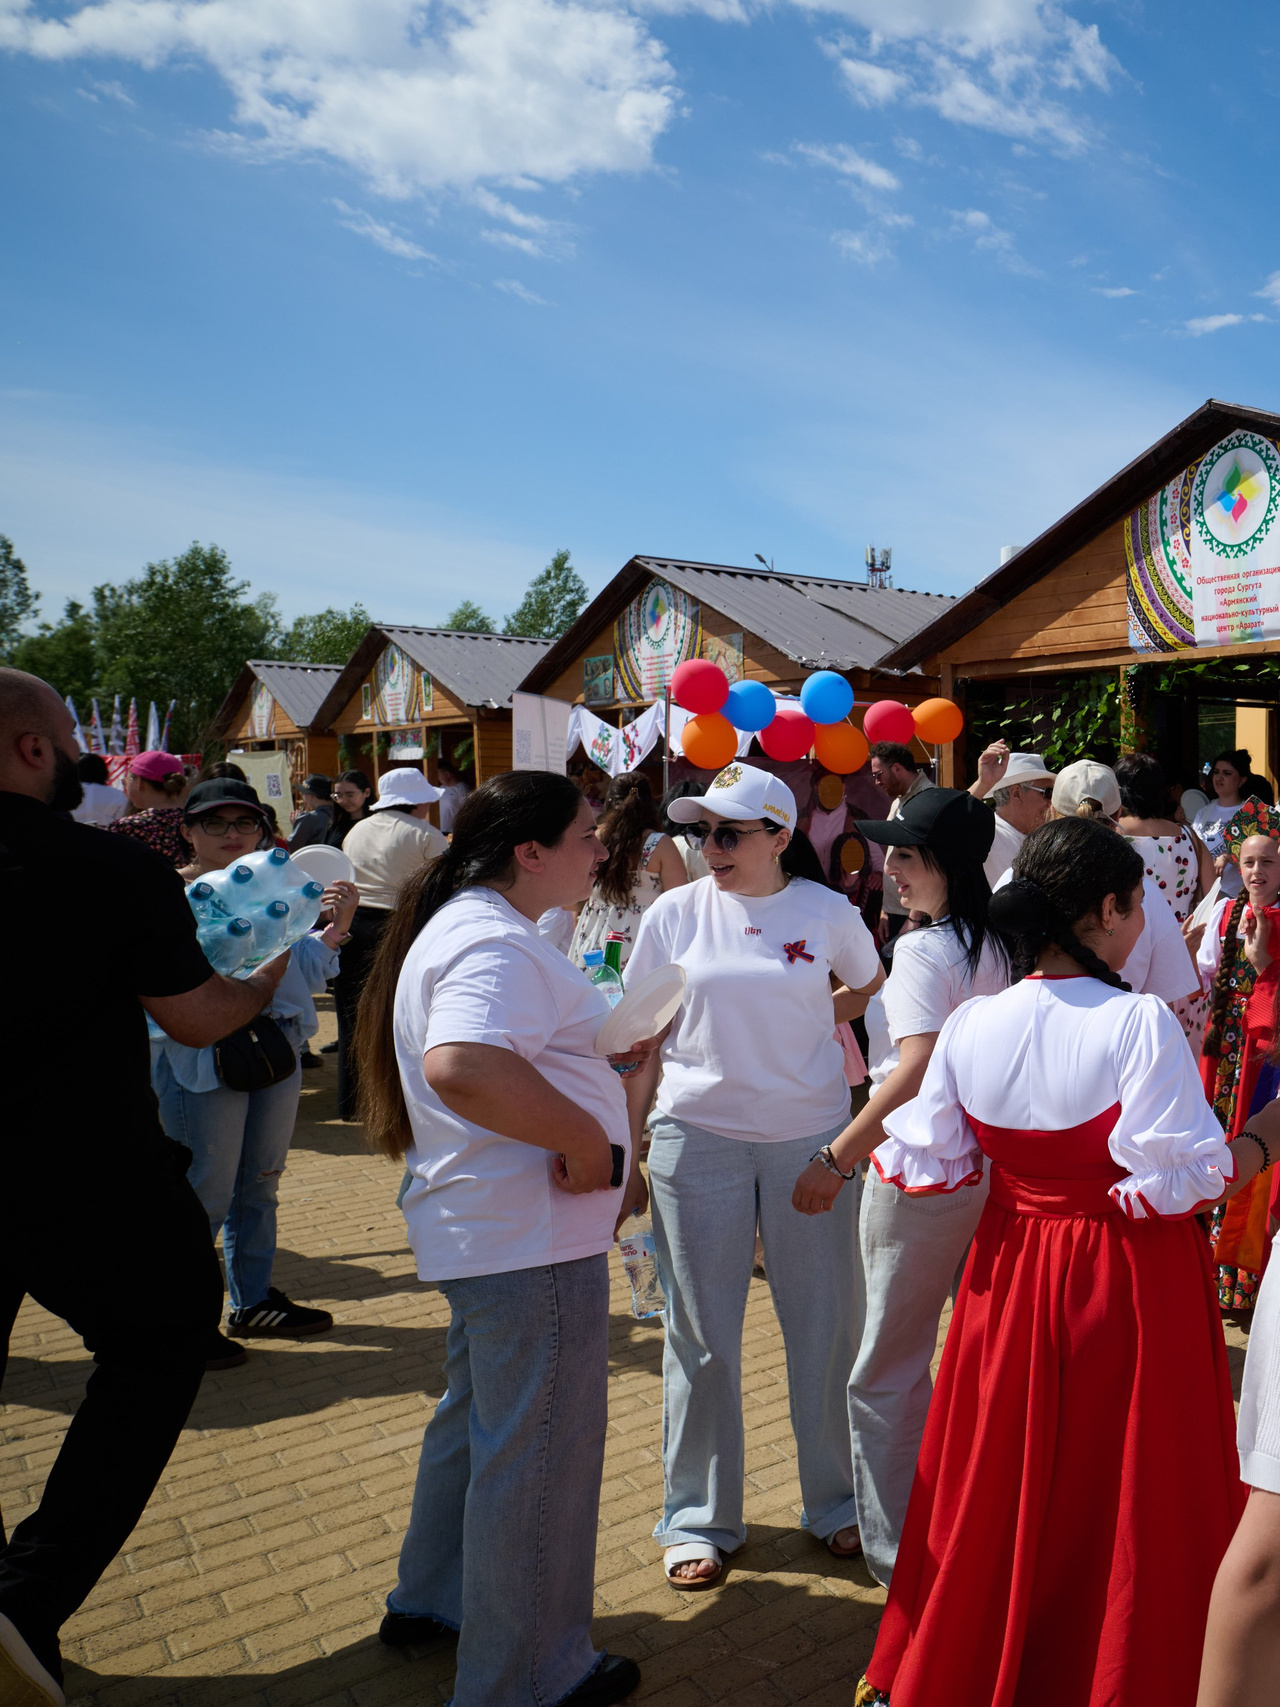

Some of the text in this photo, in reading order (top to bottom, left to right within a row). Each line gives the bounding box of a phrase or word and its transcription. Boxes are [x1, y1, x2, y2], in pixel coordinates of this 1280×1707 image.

[1196, 566, 1280, 585] Общественная организация
[1214, 582, 1262, 595] города Сургута
[1220, 594, 1257, 607] «Армянский
[1201, 604, 1279, 621] национально-культурный
[1216, 620, 1264, 632] центр «Арарат»
